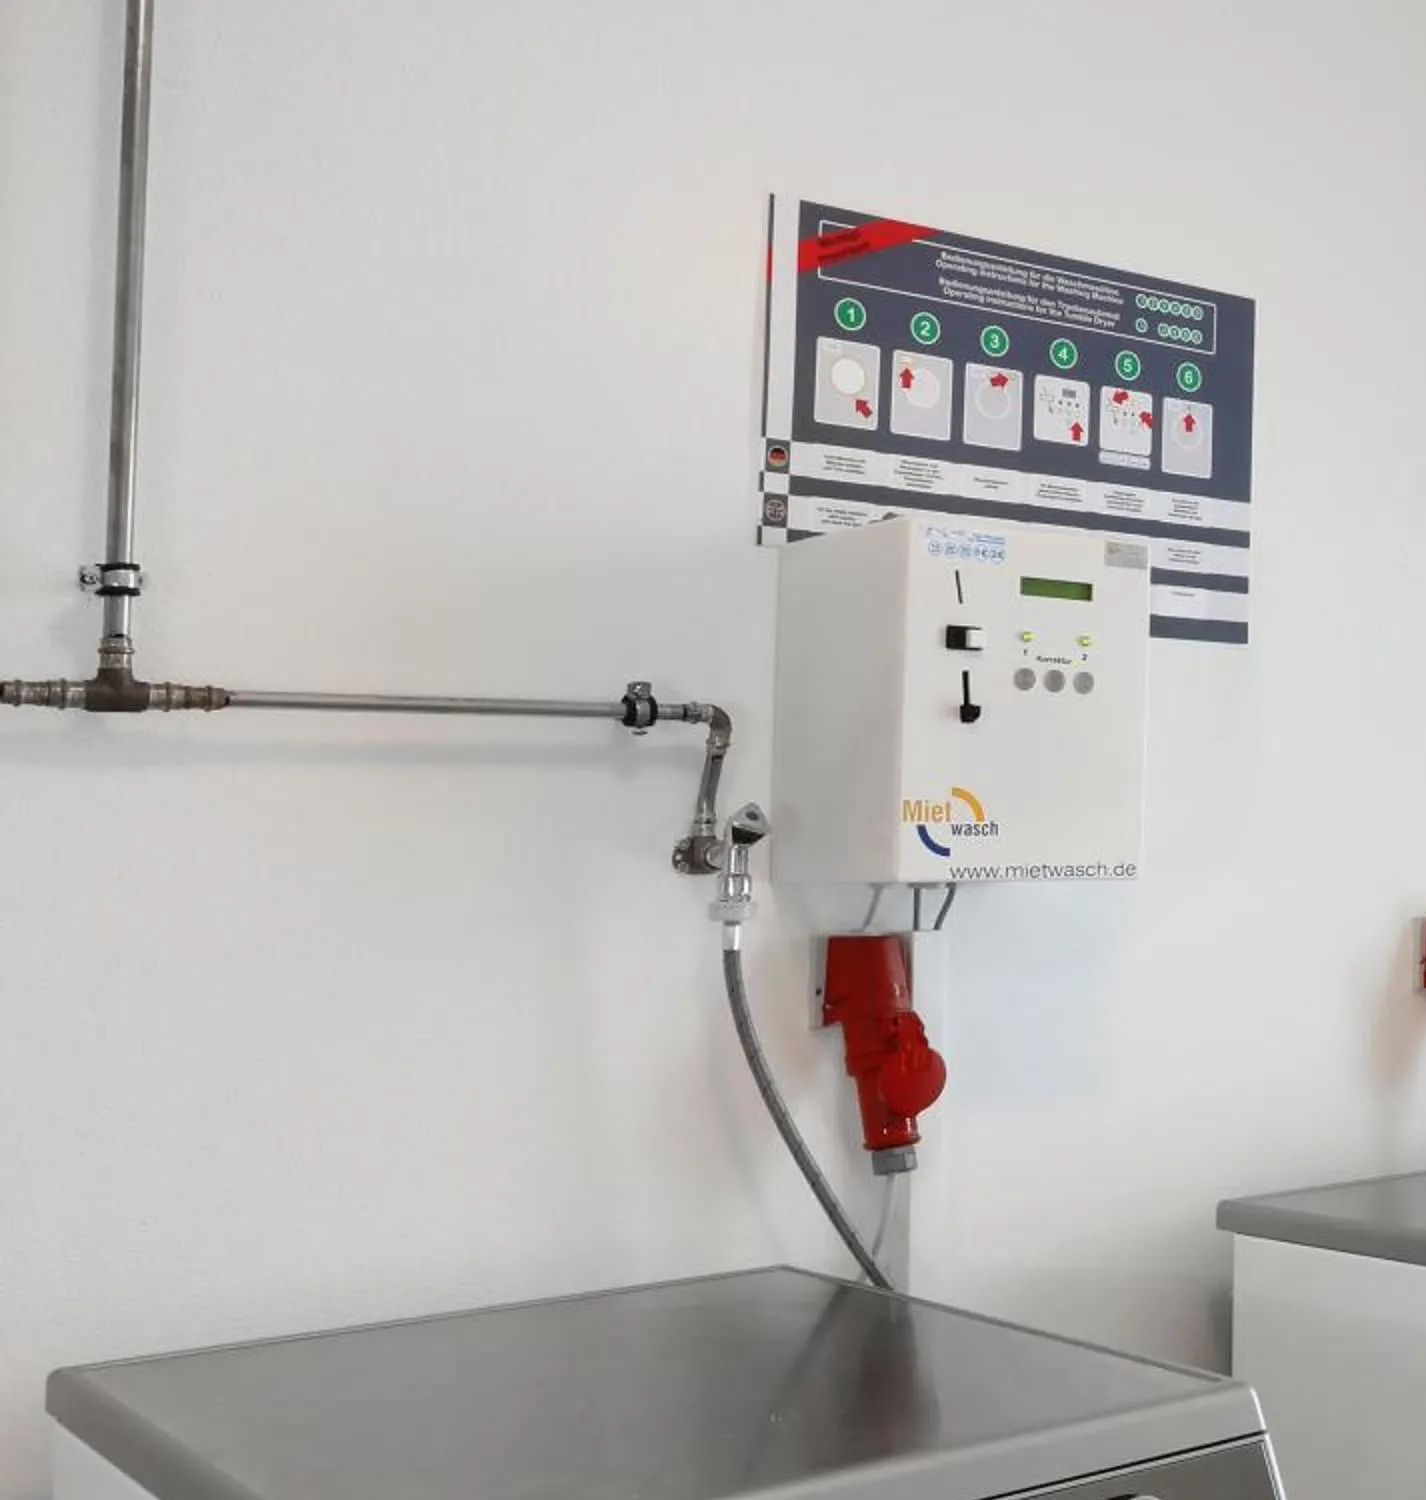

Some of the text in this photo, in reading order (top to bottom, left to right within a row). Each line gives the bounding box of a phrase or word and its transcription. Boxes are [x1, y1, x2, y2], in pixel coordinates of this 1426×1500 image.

[1093, 315, 1116, 329] Dryer
[902, 800, 951, 823] Miet
[951, 821, 1000, 837] wasch
[949, 862, 1137, 880] www.mietwasch.de
